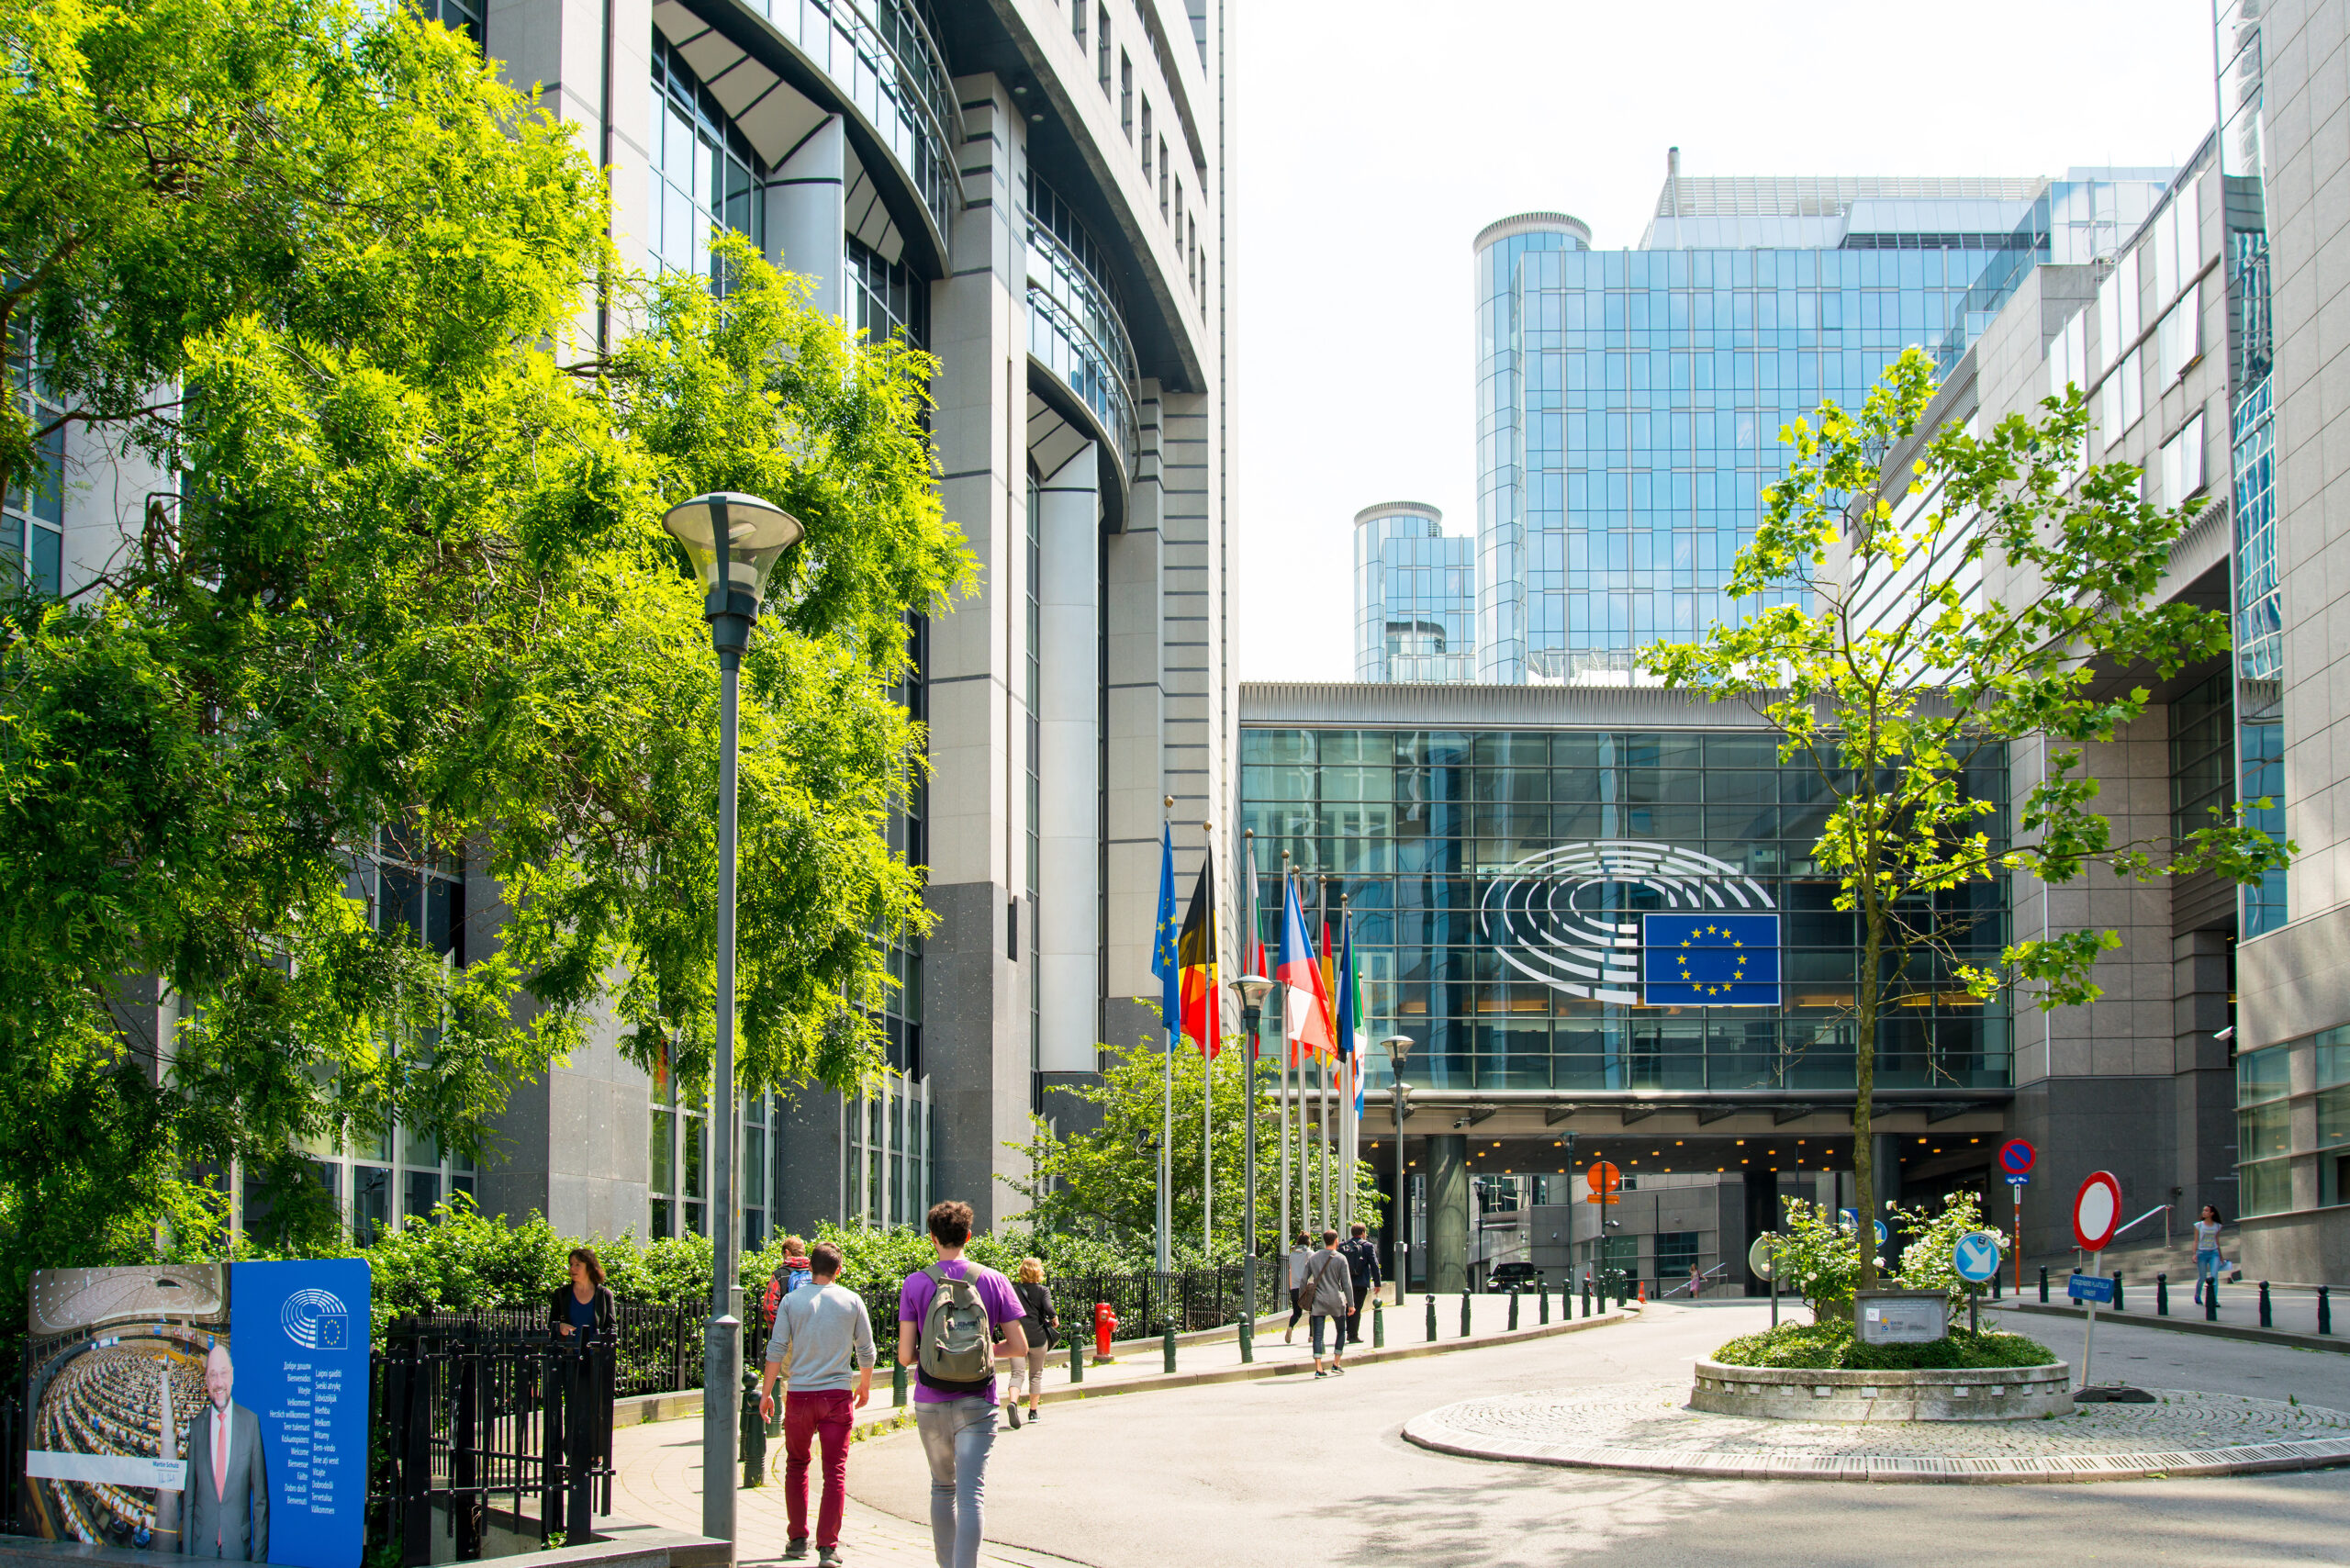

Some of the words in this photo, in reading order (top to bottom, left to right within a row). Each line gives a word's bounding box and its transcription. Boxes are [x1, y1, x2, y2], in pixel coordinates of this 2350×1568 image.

[287, 1373, 311, 1383] Bienvenidos
[286, 1397, 311, 1406] Velkommen
[269, 1409, 285, 1418] Herzlich
[285, 1410, 310, 1419] willkommen
[284, 1422, 292, 1430] Tere
[314, 1418, 331, 1428] Welkom
[314, 1430, 330, 1441] Witamy
[290, 1447, 309, 1456] Welcome
[313, 1442, 336, 1452] Bem-vindo
[287, 1459, 309, 1469] Bienvenue
[313, 1455, 322, 1464] Bine
[285, 1484, 297, 1493] Dobro
[286, 1495, 308, 1506] Benvenuti
[311, 1492, 332, 1502] Tervetuloa
